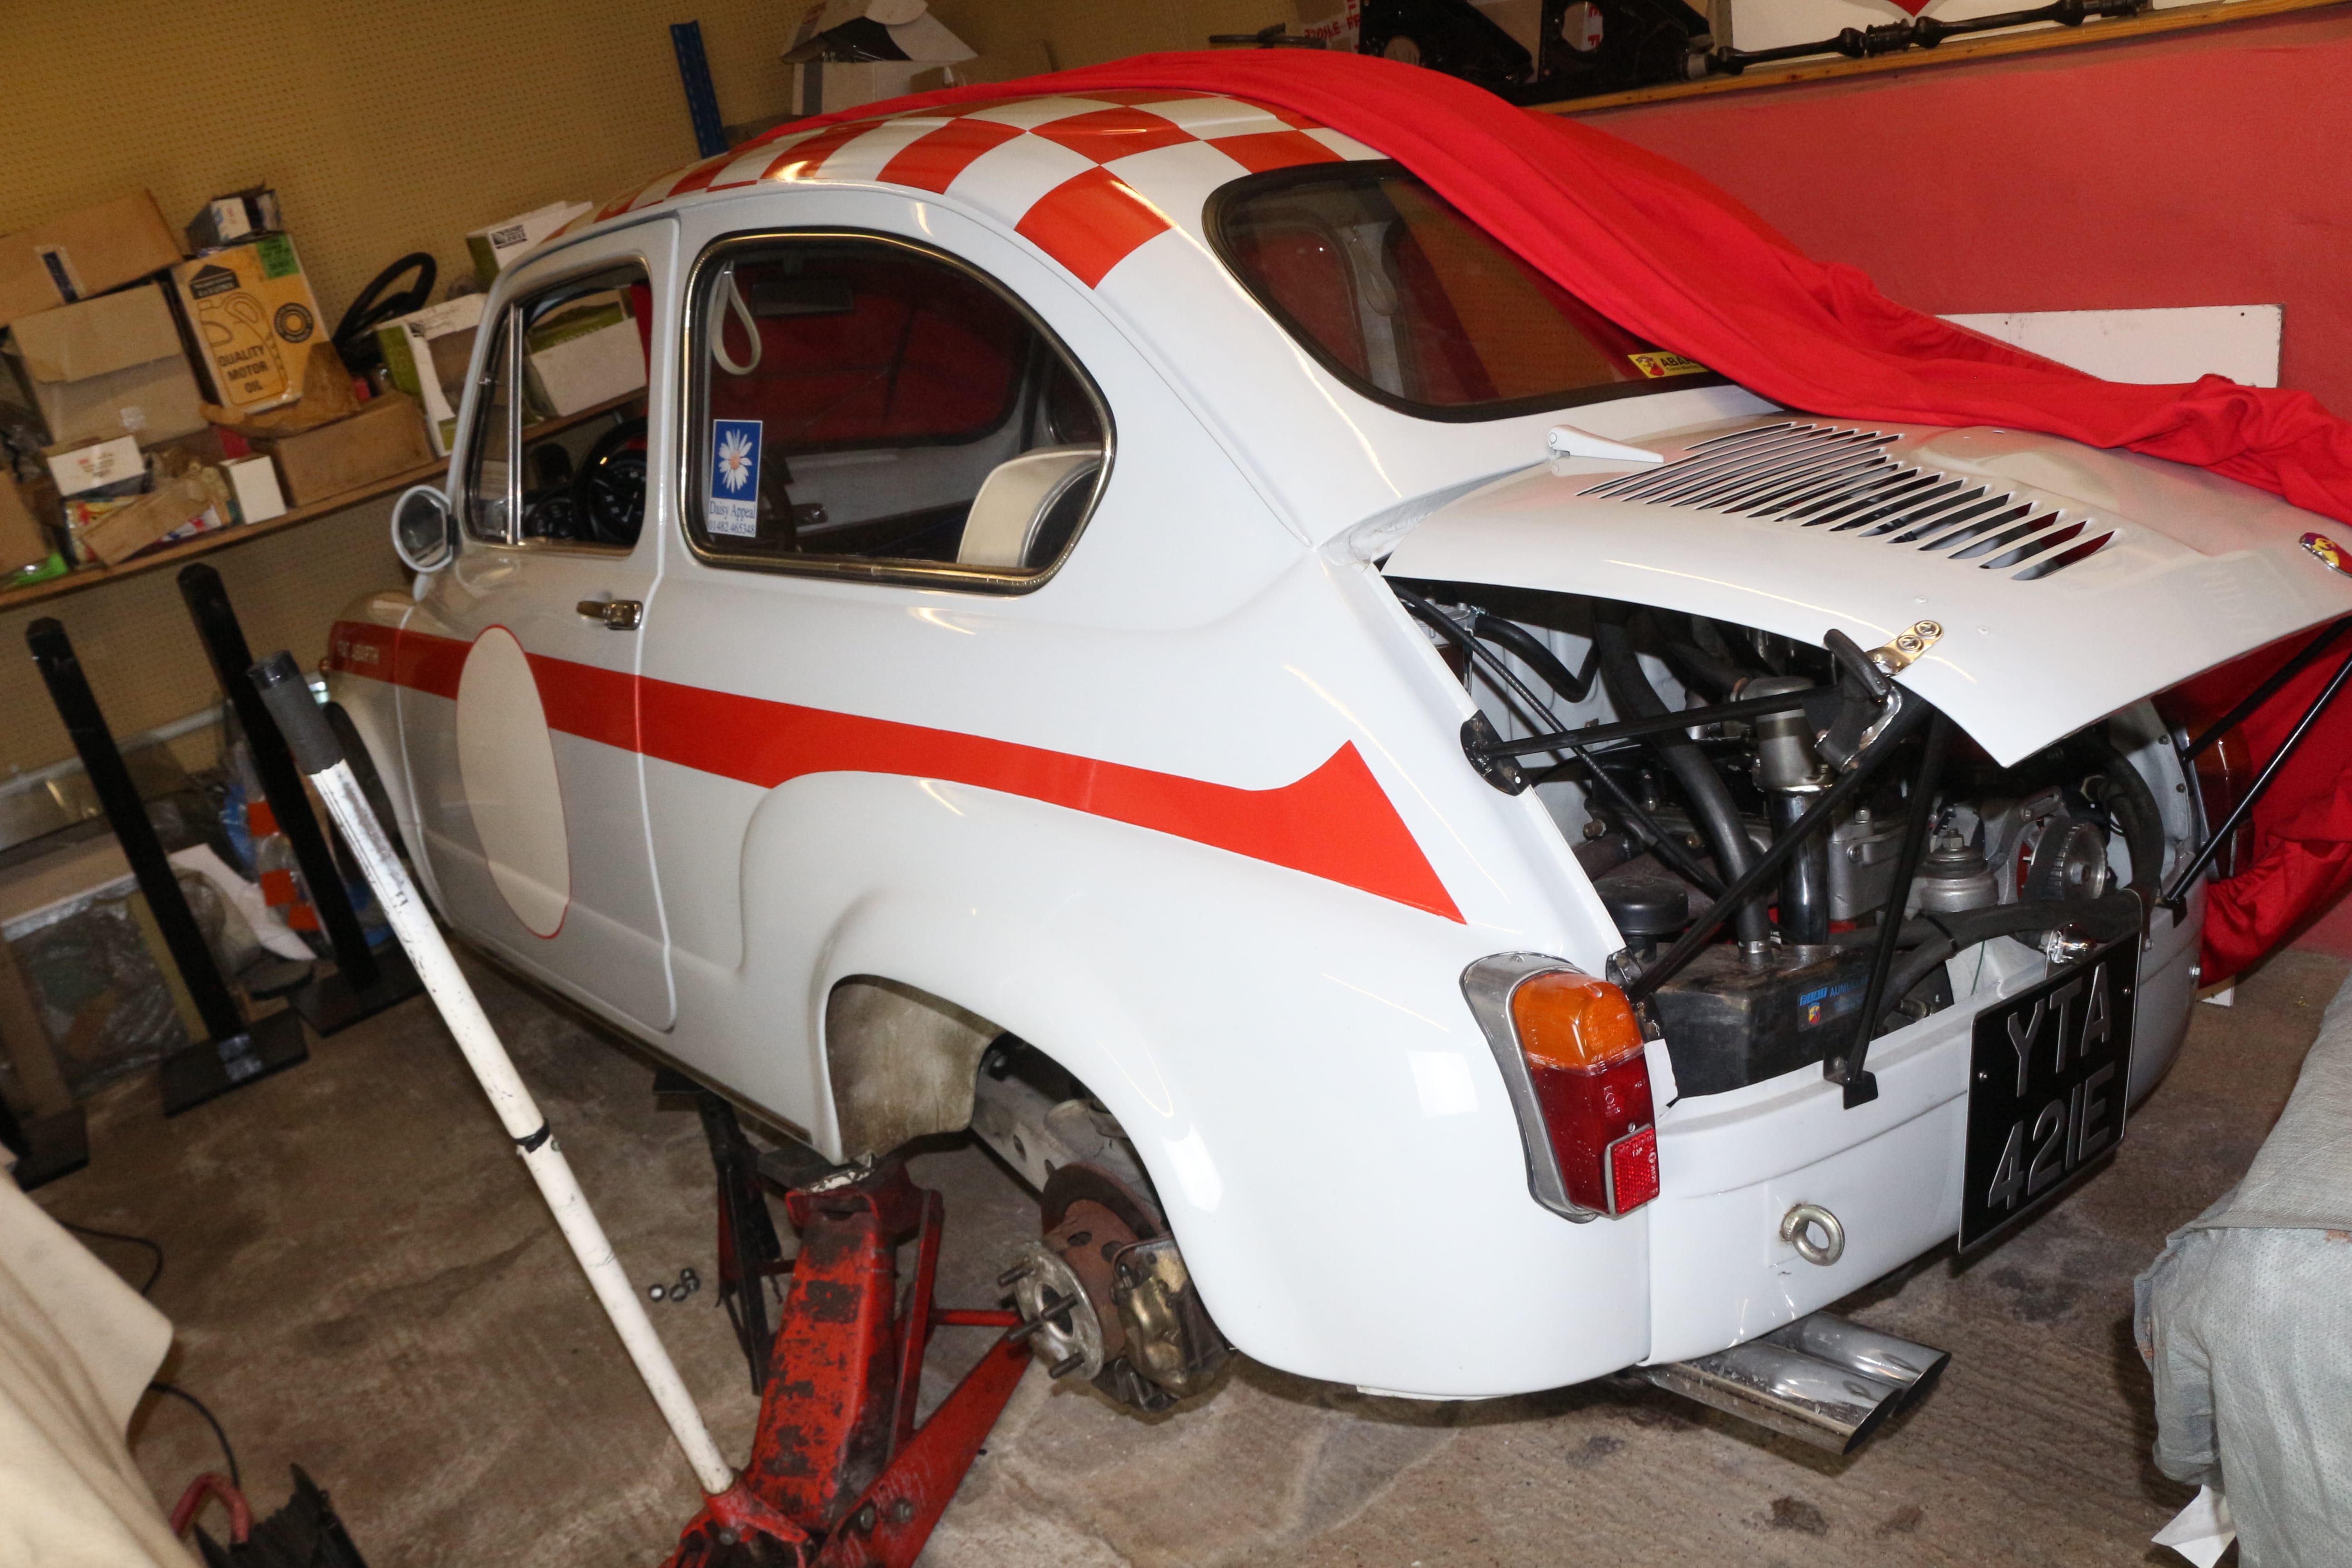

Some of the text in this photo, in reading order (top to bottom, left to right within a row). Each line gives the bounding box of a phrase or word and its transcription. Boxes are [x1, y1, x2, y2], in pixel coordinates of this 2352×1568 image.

[217, 345, 264, 367] QUALITY
[228, 361, 268, 381] MOTOR
[245, 380, 263, 393] OIL
[710, 501, 755, 522] Daisy Appeal
[709, 520, 755, 535] 01482 465348
[2008, 962, 2111, 1098] YTA
[1988, 1061, 2115, 1210] 421E
